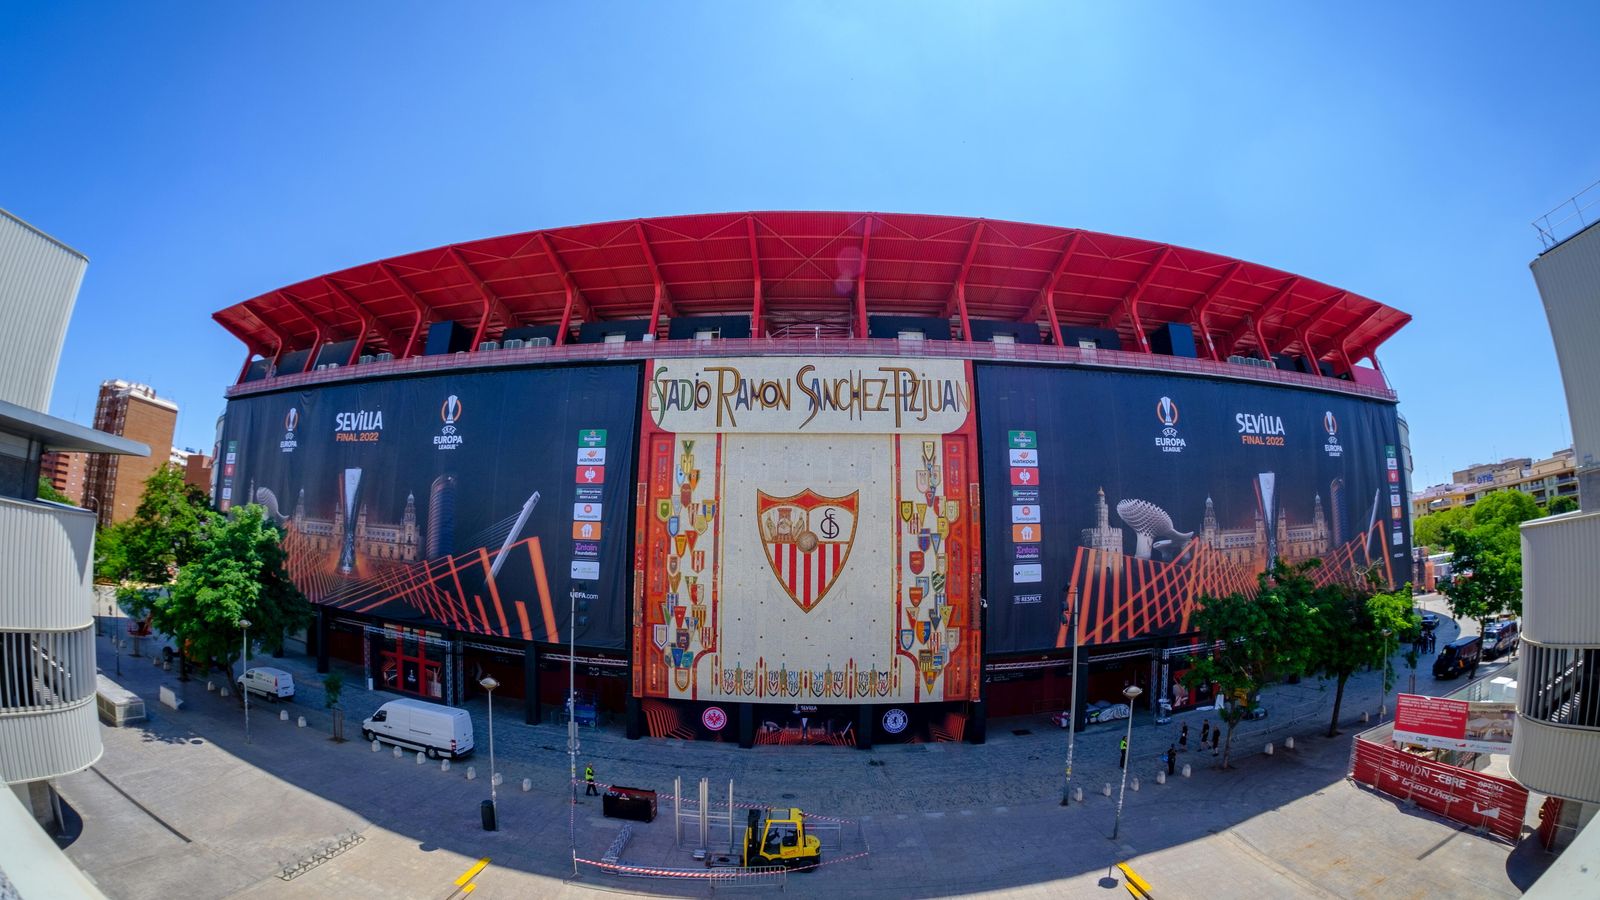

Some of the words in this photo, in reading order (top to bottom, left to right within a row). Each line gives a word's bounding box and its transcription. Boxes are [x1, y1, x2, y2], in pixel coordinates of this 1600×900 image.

[704, 366, 791, 427] RAMON
[796, 364, 889, 430] SANCHEZ
[441, 425, 457, 436] UEFA
[1162, 427, 1178, 437] UEFA
[336, 433, 358, 442] FINAL
[360, 432, 379, 441] 2022
[433, 435, 463, 445] EUROPA
[1155, 437, 1186, 447] EUROPA
[1242, 435, 1265, 445] FINAL
[1266, 436, 1284, 446] 2022
[280, 440, 297, 448] EUROPA
[1325, 444, 1343, 452] EUROPA
[570, 591, 599, 600] UEFA.com
[1402, 777, 1428, 792] Grupo
